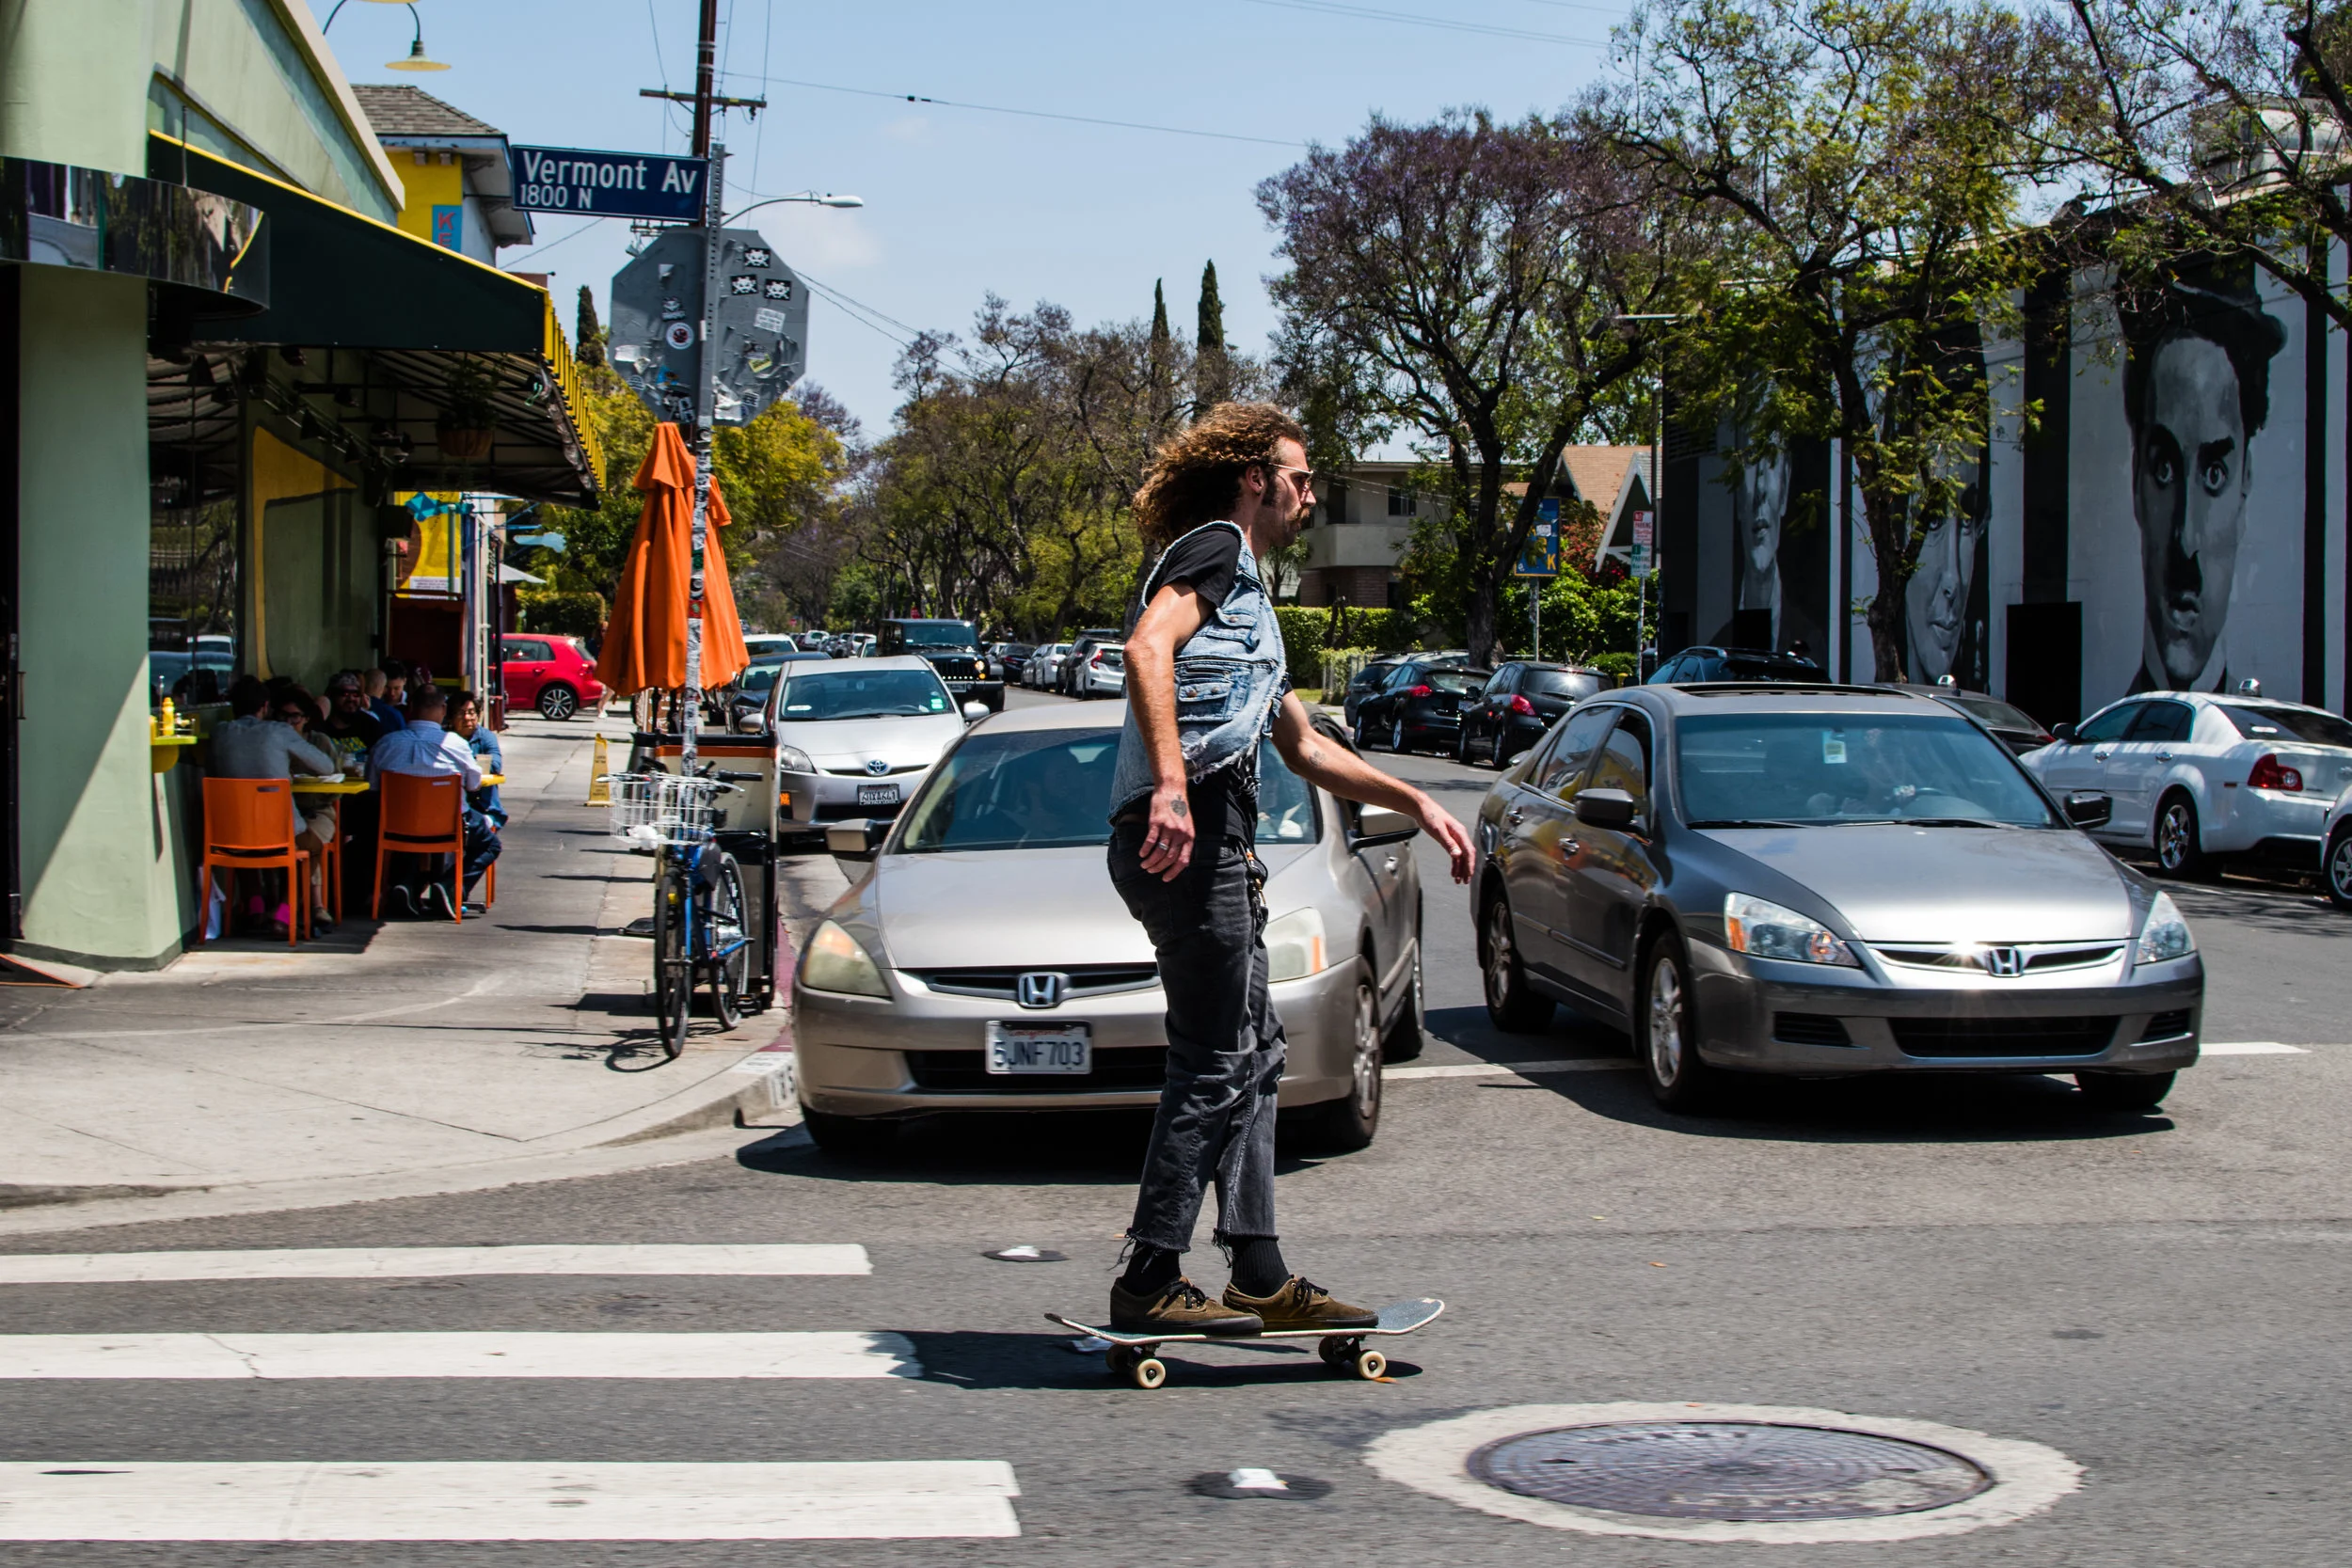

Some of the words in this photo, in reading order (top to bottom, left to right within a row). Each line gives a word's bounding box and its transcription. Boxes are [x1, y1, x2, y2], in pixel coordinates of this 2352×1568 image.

[523, 150, 647, 190] Vermont
[660, 161, 697, 194] Av
[519, 183, 568, 207] 1800
[578, 188, 592, 209] N
[993, 1040, 1086, 1068] 5JNF703
